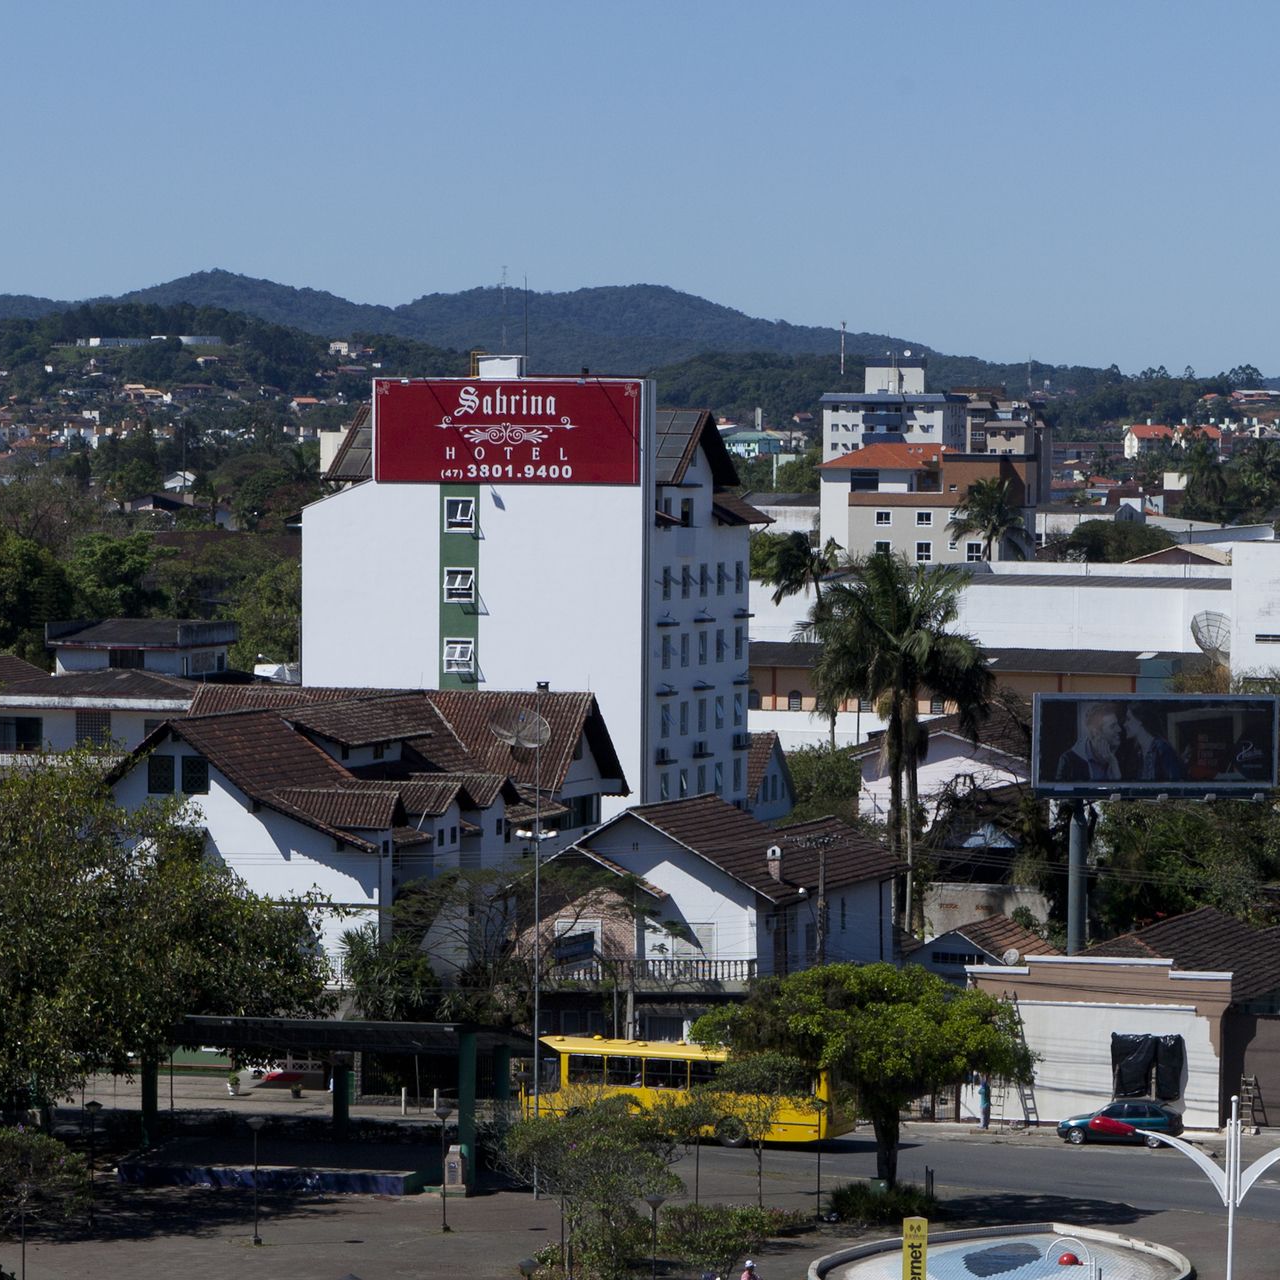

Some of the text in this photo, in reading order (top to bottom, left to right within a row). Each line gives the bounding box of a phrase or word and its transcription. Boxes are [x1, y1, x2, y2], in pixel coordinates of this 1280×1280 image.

[454, 386, 556, 417] Sabrina
[446, 446, 568, 461] HOTEL
[440, 464, 573, 479] (47) 3801.9400
